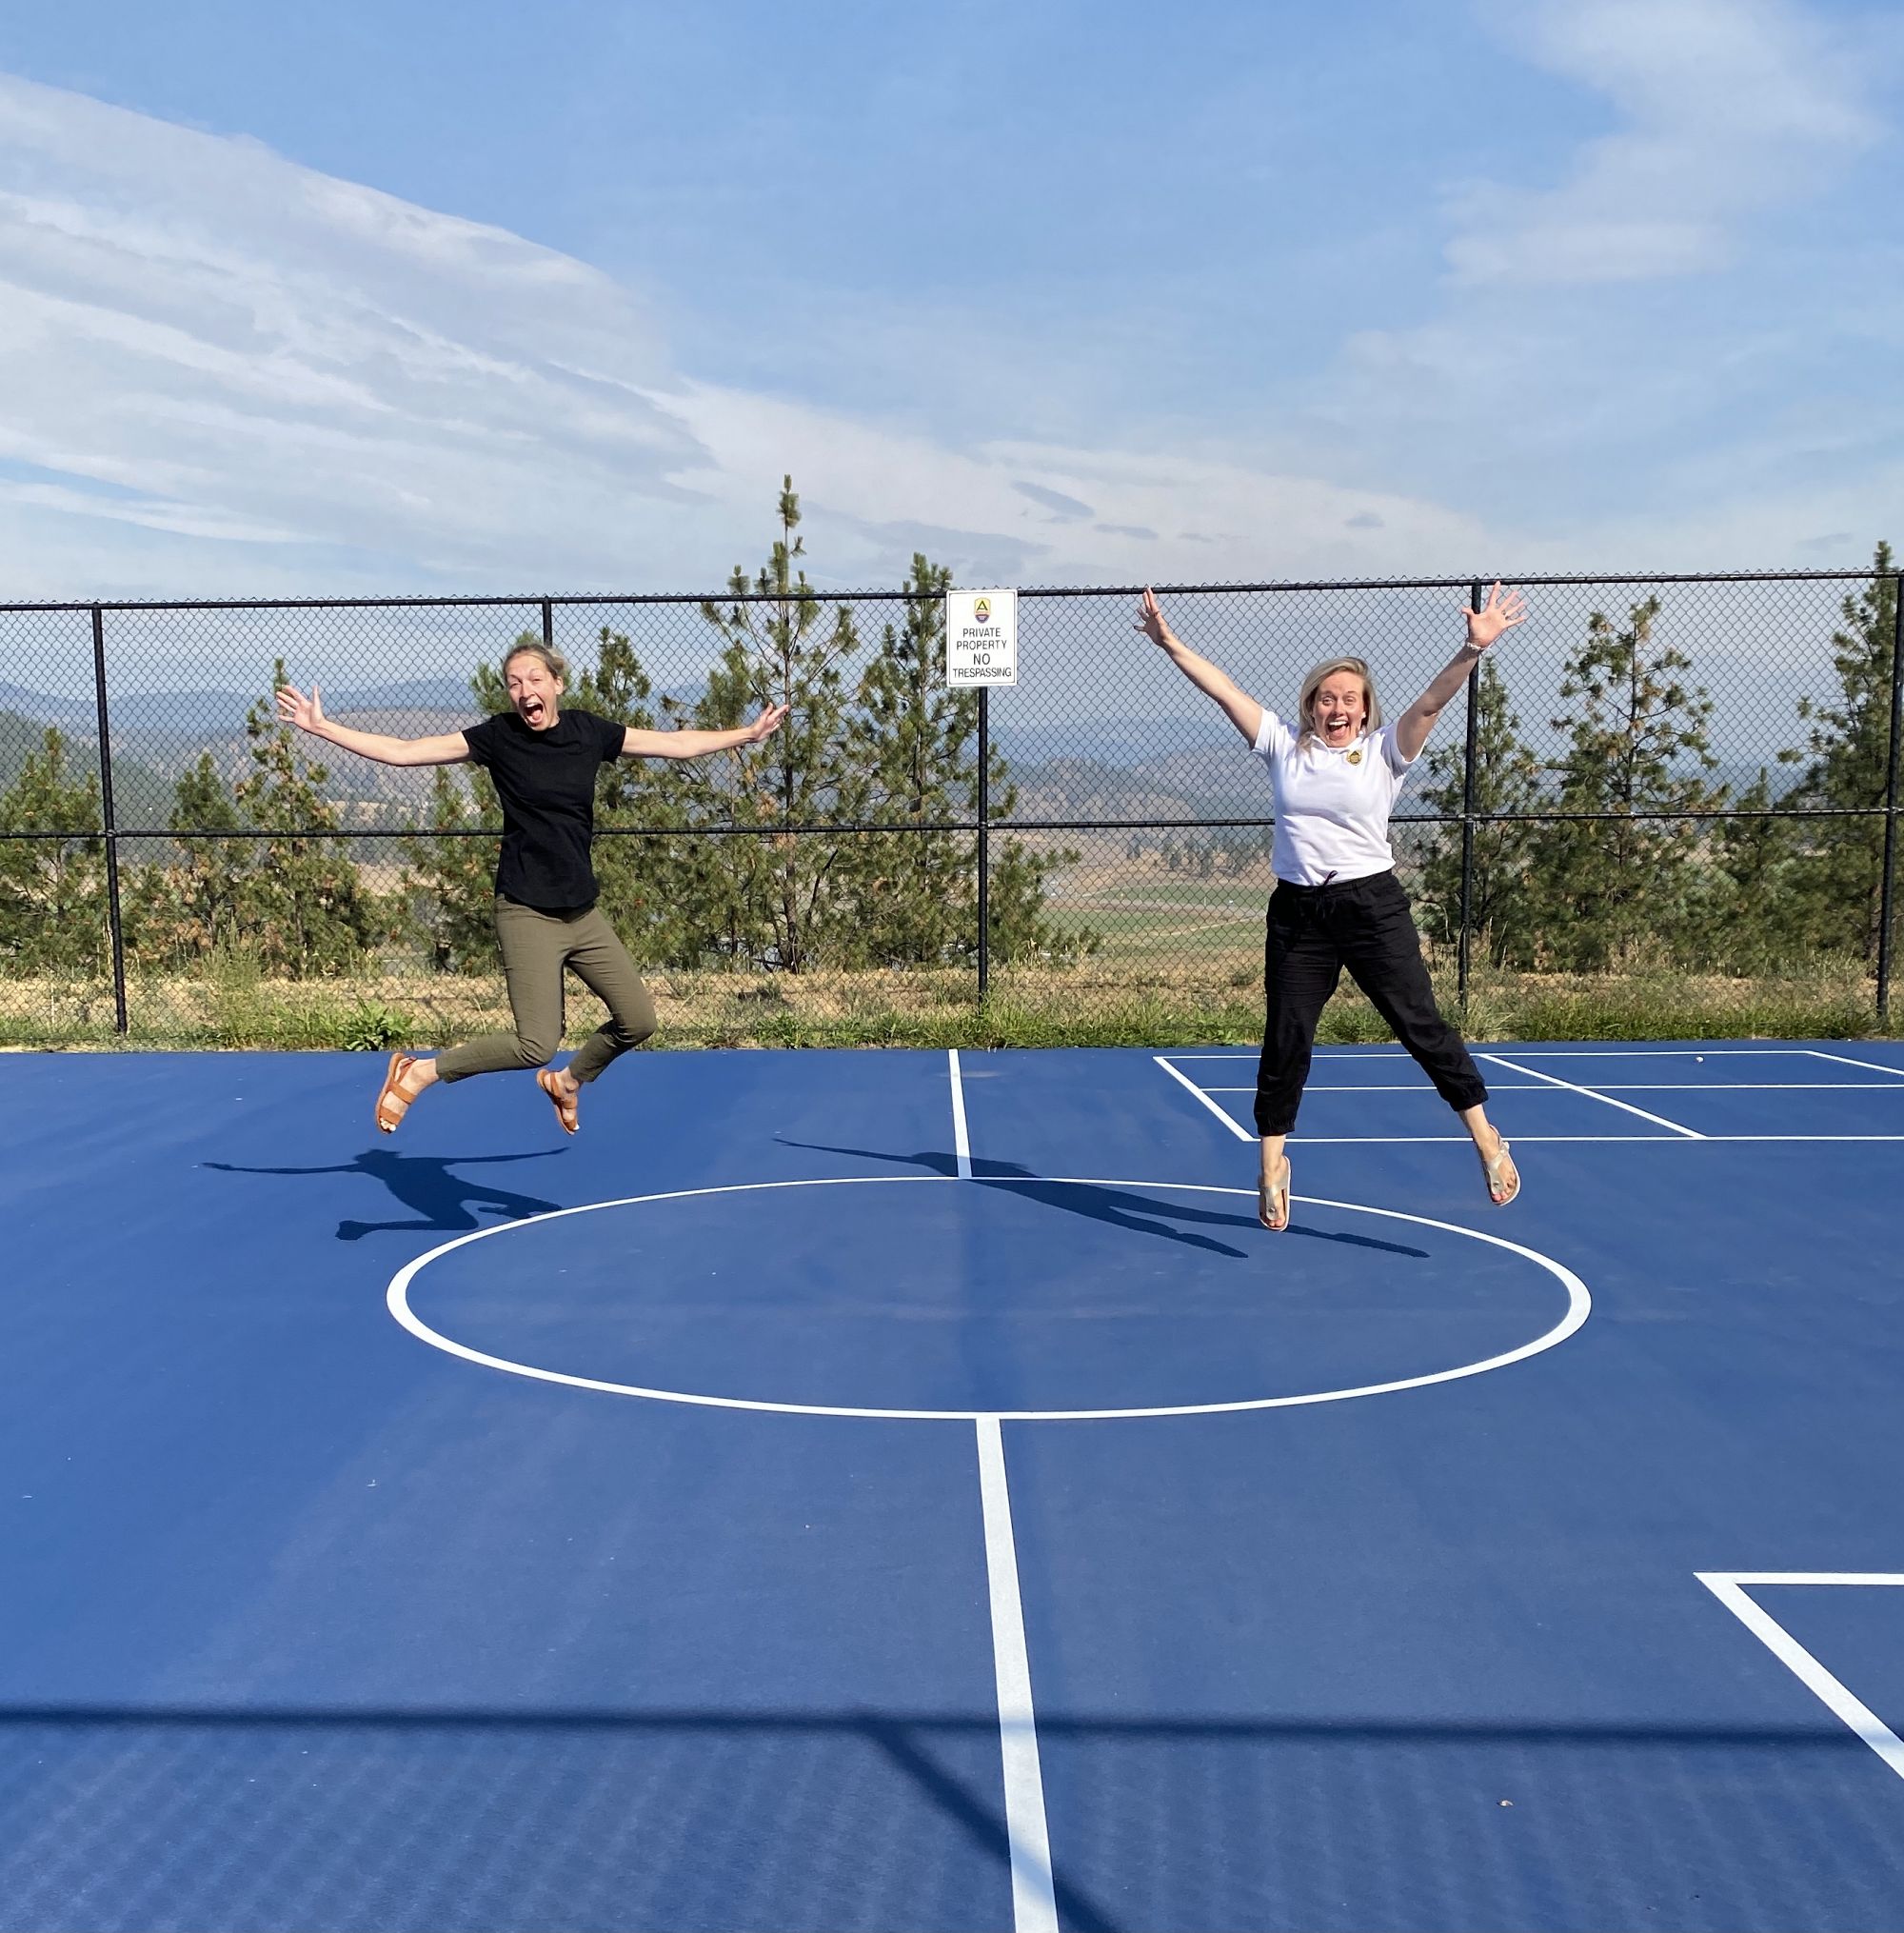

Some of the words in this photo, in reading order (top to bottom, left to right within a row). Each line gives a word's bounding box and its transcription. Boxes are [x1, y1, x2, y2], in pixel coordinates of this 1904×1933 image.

[962, 628, 1002, 638] PRIVATE
[956, 640, 1007, 650] PROPERTY
[973, 653, 991, 666] NO
[952, 667, 1012, 678] TRESPASSING
